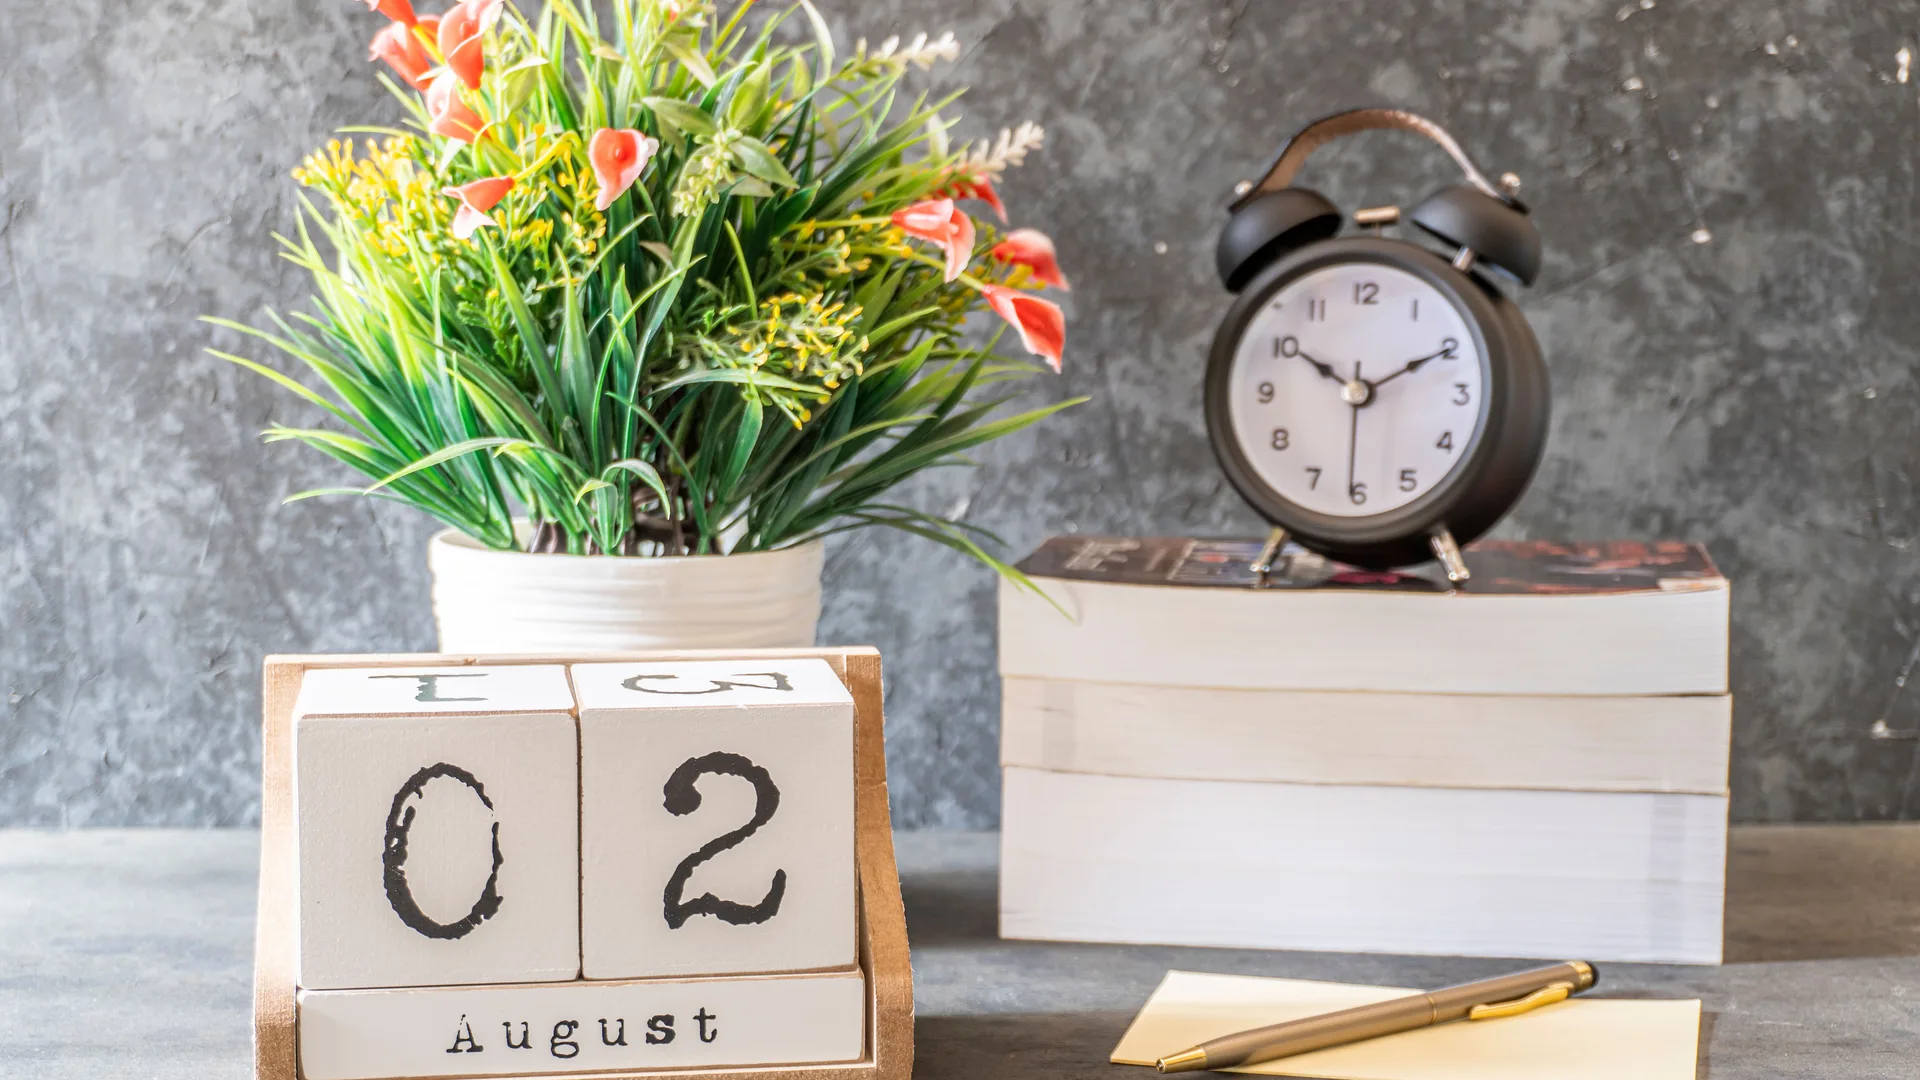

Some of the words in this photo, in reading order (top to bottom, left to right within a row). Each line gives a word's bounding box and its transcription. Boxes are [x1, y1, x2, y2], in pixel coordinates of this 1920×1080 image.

[1353, 282, 1379, 305] 12
[1309, 298, 1326, 321] 11
[1411, 298, 1419, 321] 1
[1273, 335, 1299, 358] 10
[1441, 337, 1459, 360] 2
[1258, 382, 1275, 404] 9
[1452, 383, 1470, 406] 3
[1271, 428, 1290, 451] 8
[1436, 431, 1454, 453] 4
[1305, 467, 1322, 490] 7
[1399, 469, 1418, 492] 5
[1350, 482, 1367, 505] 6
[662, 751, 787, 930] 2
[445, 1006, 718, 1059] August
